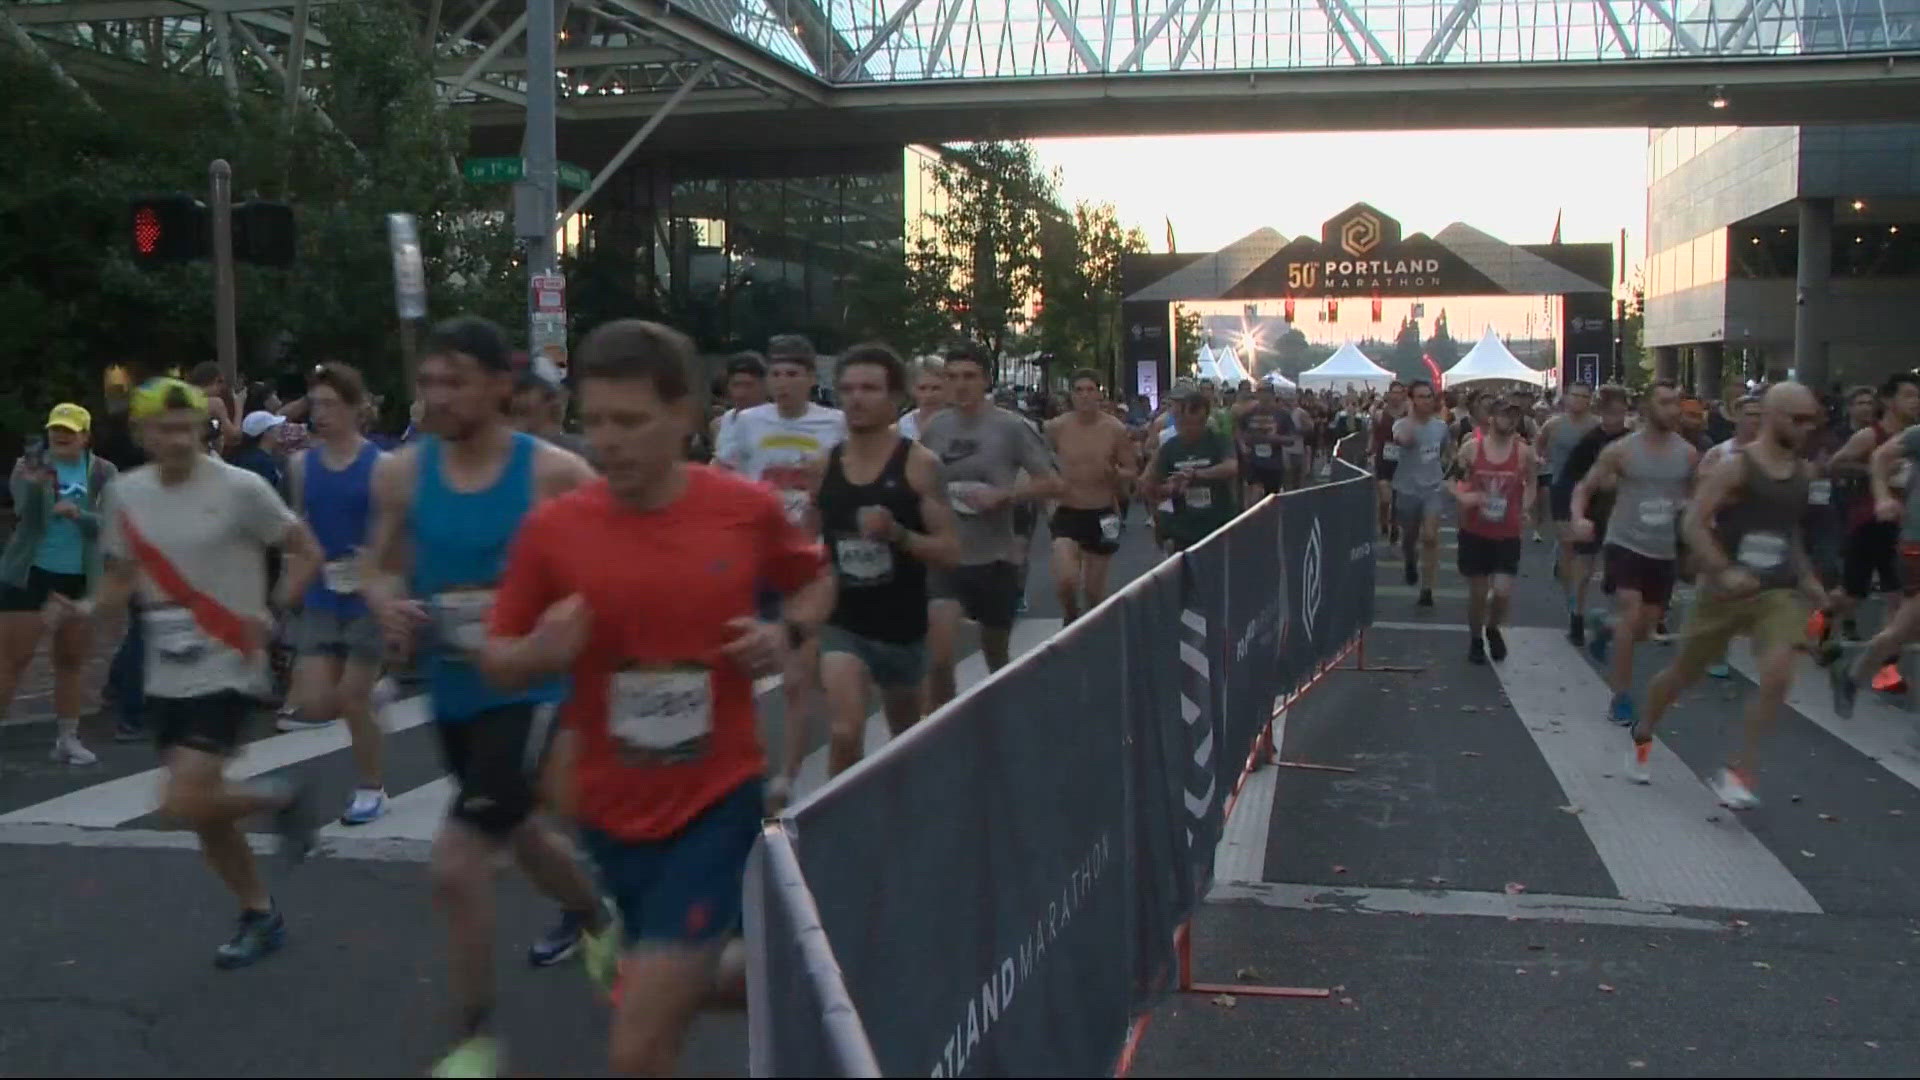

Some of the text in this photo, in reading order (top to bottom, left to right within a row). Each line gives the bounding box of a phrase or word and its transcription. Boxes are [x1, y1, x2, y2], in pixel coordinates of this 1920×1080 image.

[1325, 259, 1439, 275] PORTLAND
[1325, 277, 1440, 288] MARATHON
[1019, 833, 1109, 985] MARATHON
